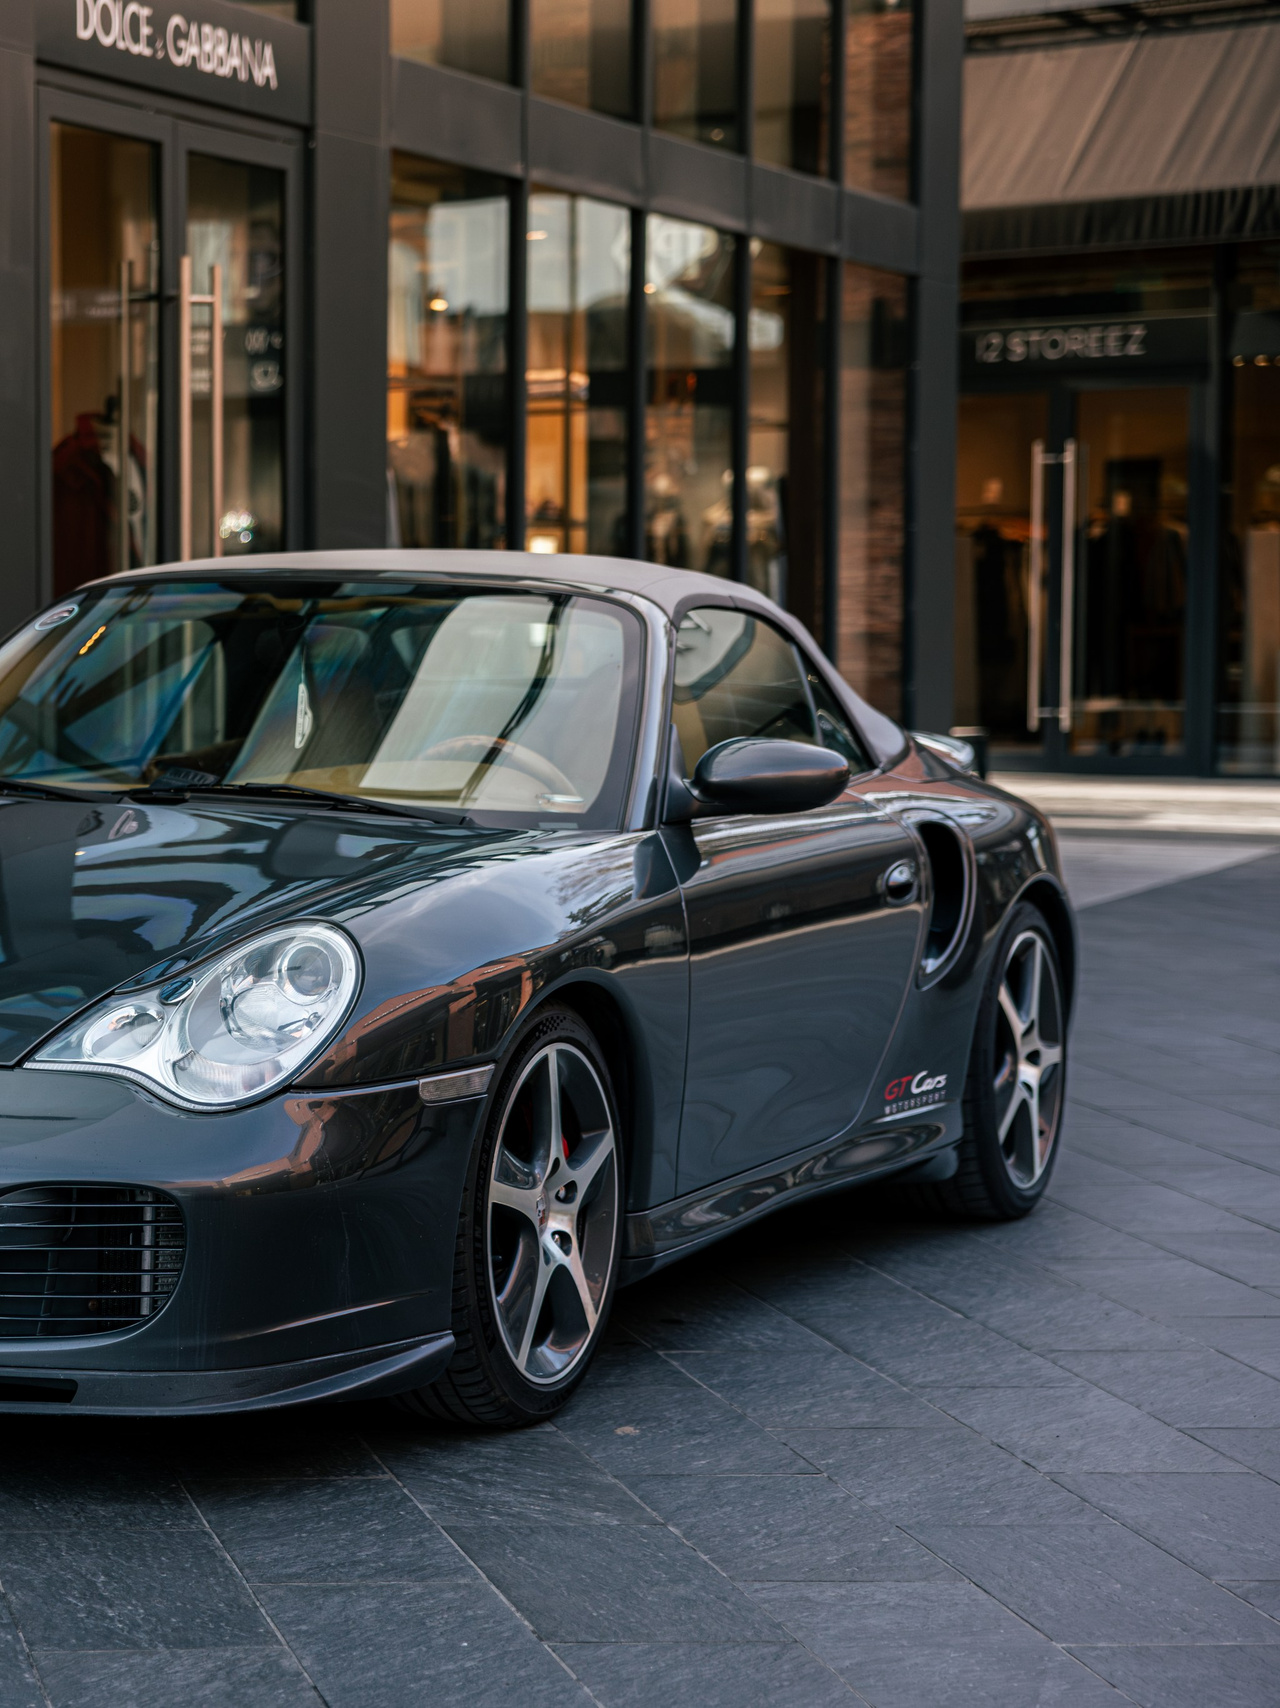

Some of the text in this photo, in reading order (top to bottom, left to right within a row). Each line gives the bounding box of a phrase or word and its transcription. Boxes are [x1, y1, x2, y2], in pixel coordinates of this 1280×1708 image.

[76, 0, 153, 56] DOLCE
[166, 14, 278, 90] GABBANA
[1005, 323, 1148, 362] STOREEZ
[474, 1224, 491, 1324] MICHELIN
